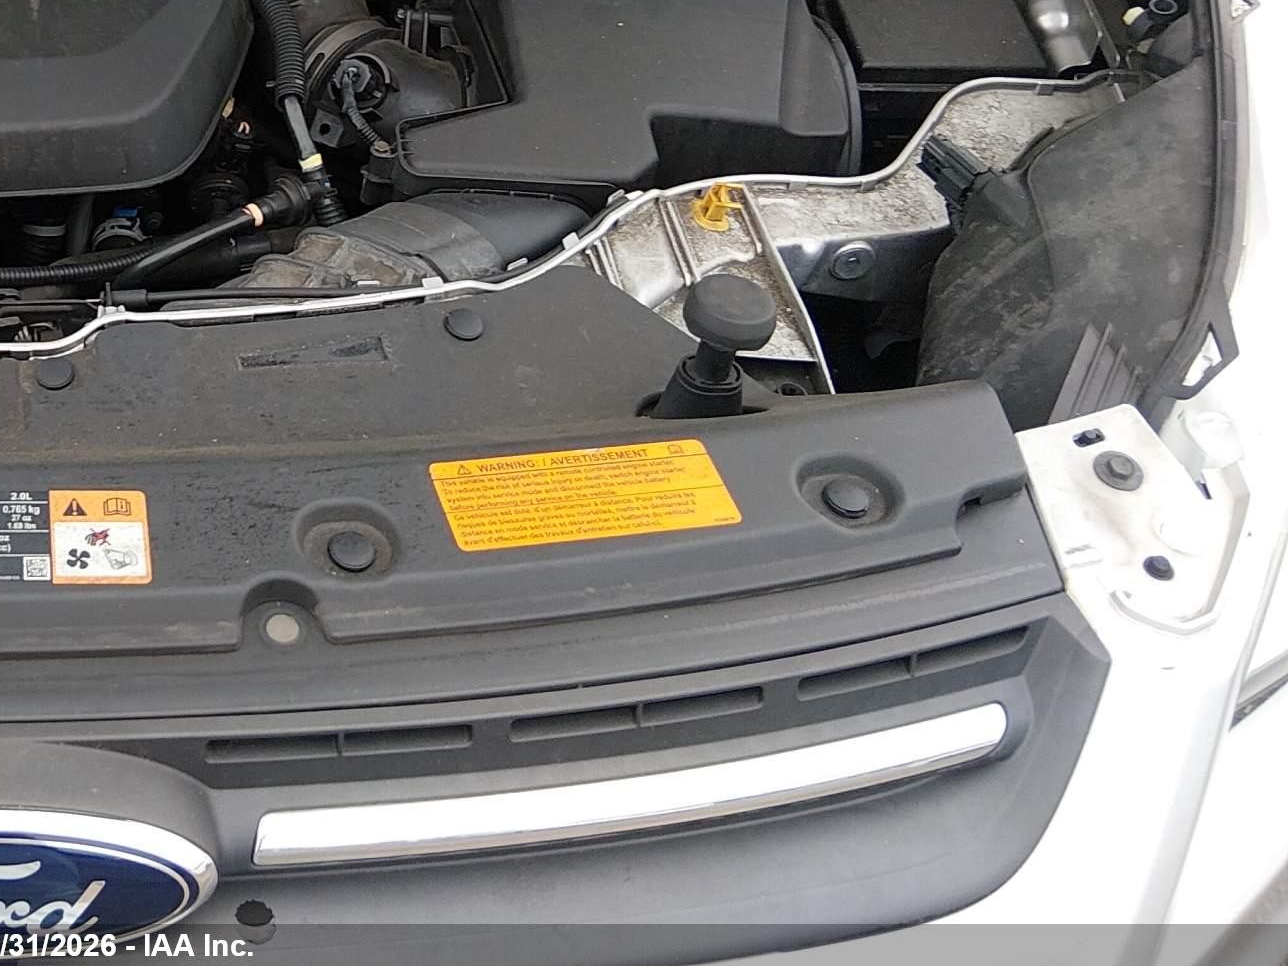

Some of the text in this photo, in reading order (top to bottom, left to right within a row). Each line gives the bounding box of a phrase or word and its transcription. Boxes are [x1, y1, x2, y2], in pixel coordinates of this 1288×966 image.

[477, 448, 648, 473] WARNING: / AVERTISSEMENT
[10, 492, 33, 501] 2.0L
[28, 505, 41, 515] kg
